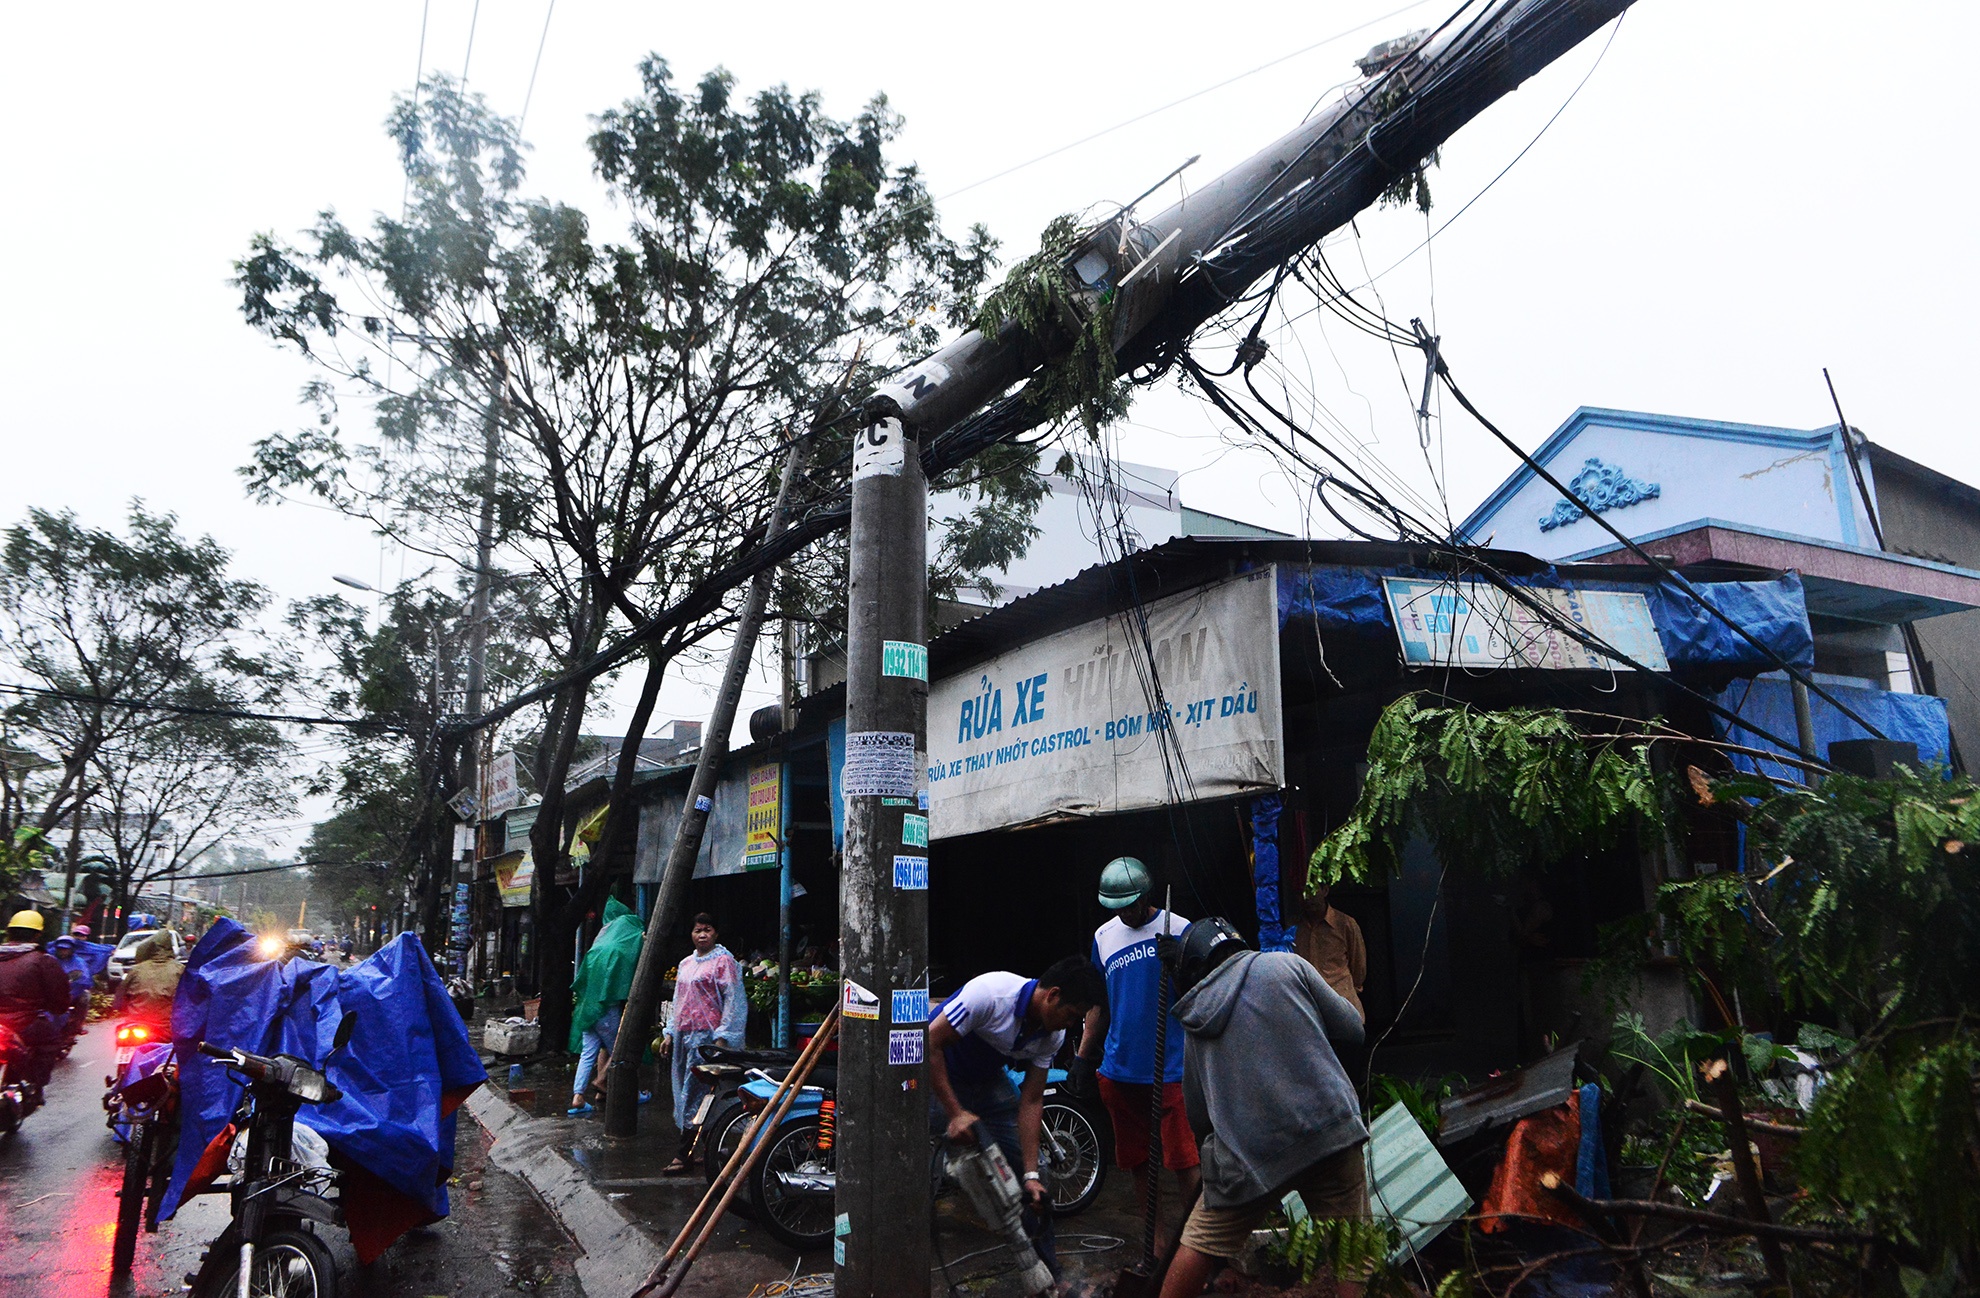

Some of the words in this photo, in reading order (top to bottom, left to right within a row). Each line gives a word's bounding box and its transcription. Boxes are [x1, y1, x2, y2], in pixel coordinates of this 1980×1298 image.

[928, 758, 946, 783] RỬA
[949, 759, 963, 778] XE
[965, 751, 993, 774] THAY
[996, 737, 1029, 766] NHỚT
[1031, 726, 1091, 757] CASTROL
[1105, 714, 1142, 742] BƠM
[1185, 698, 1216, 729] XỊT
[1220, 681, 1258, 718] DẦU
[958, 674, 1002, 744] RỬA
[1011, 672, 1048, 728] XE
